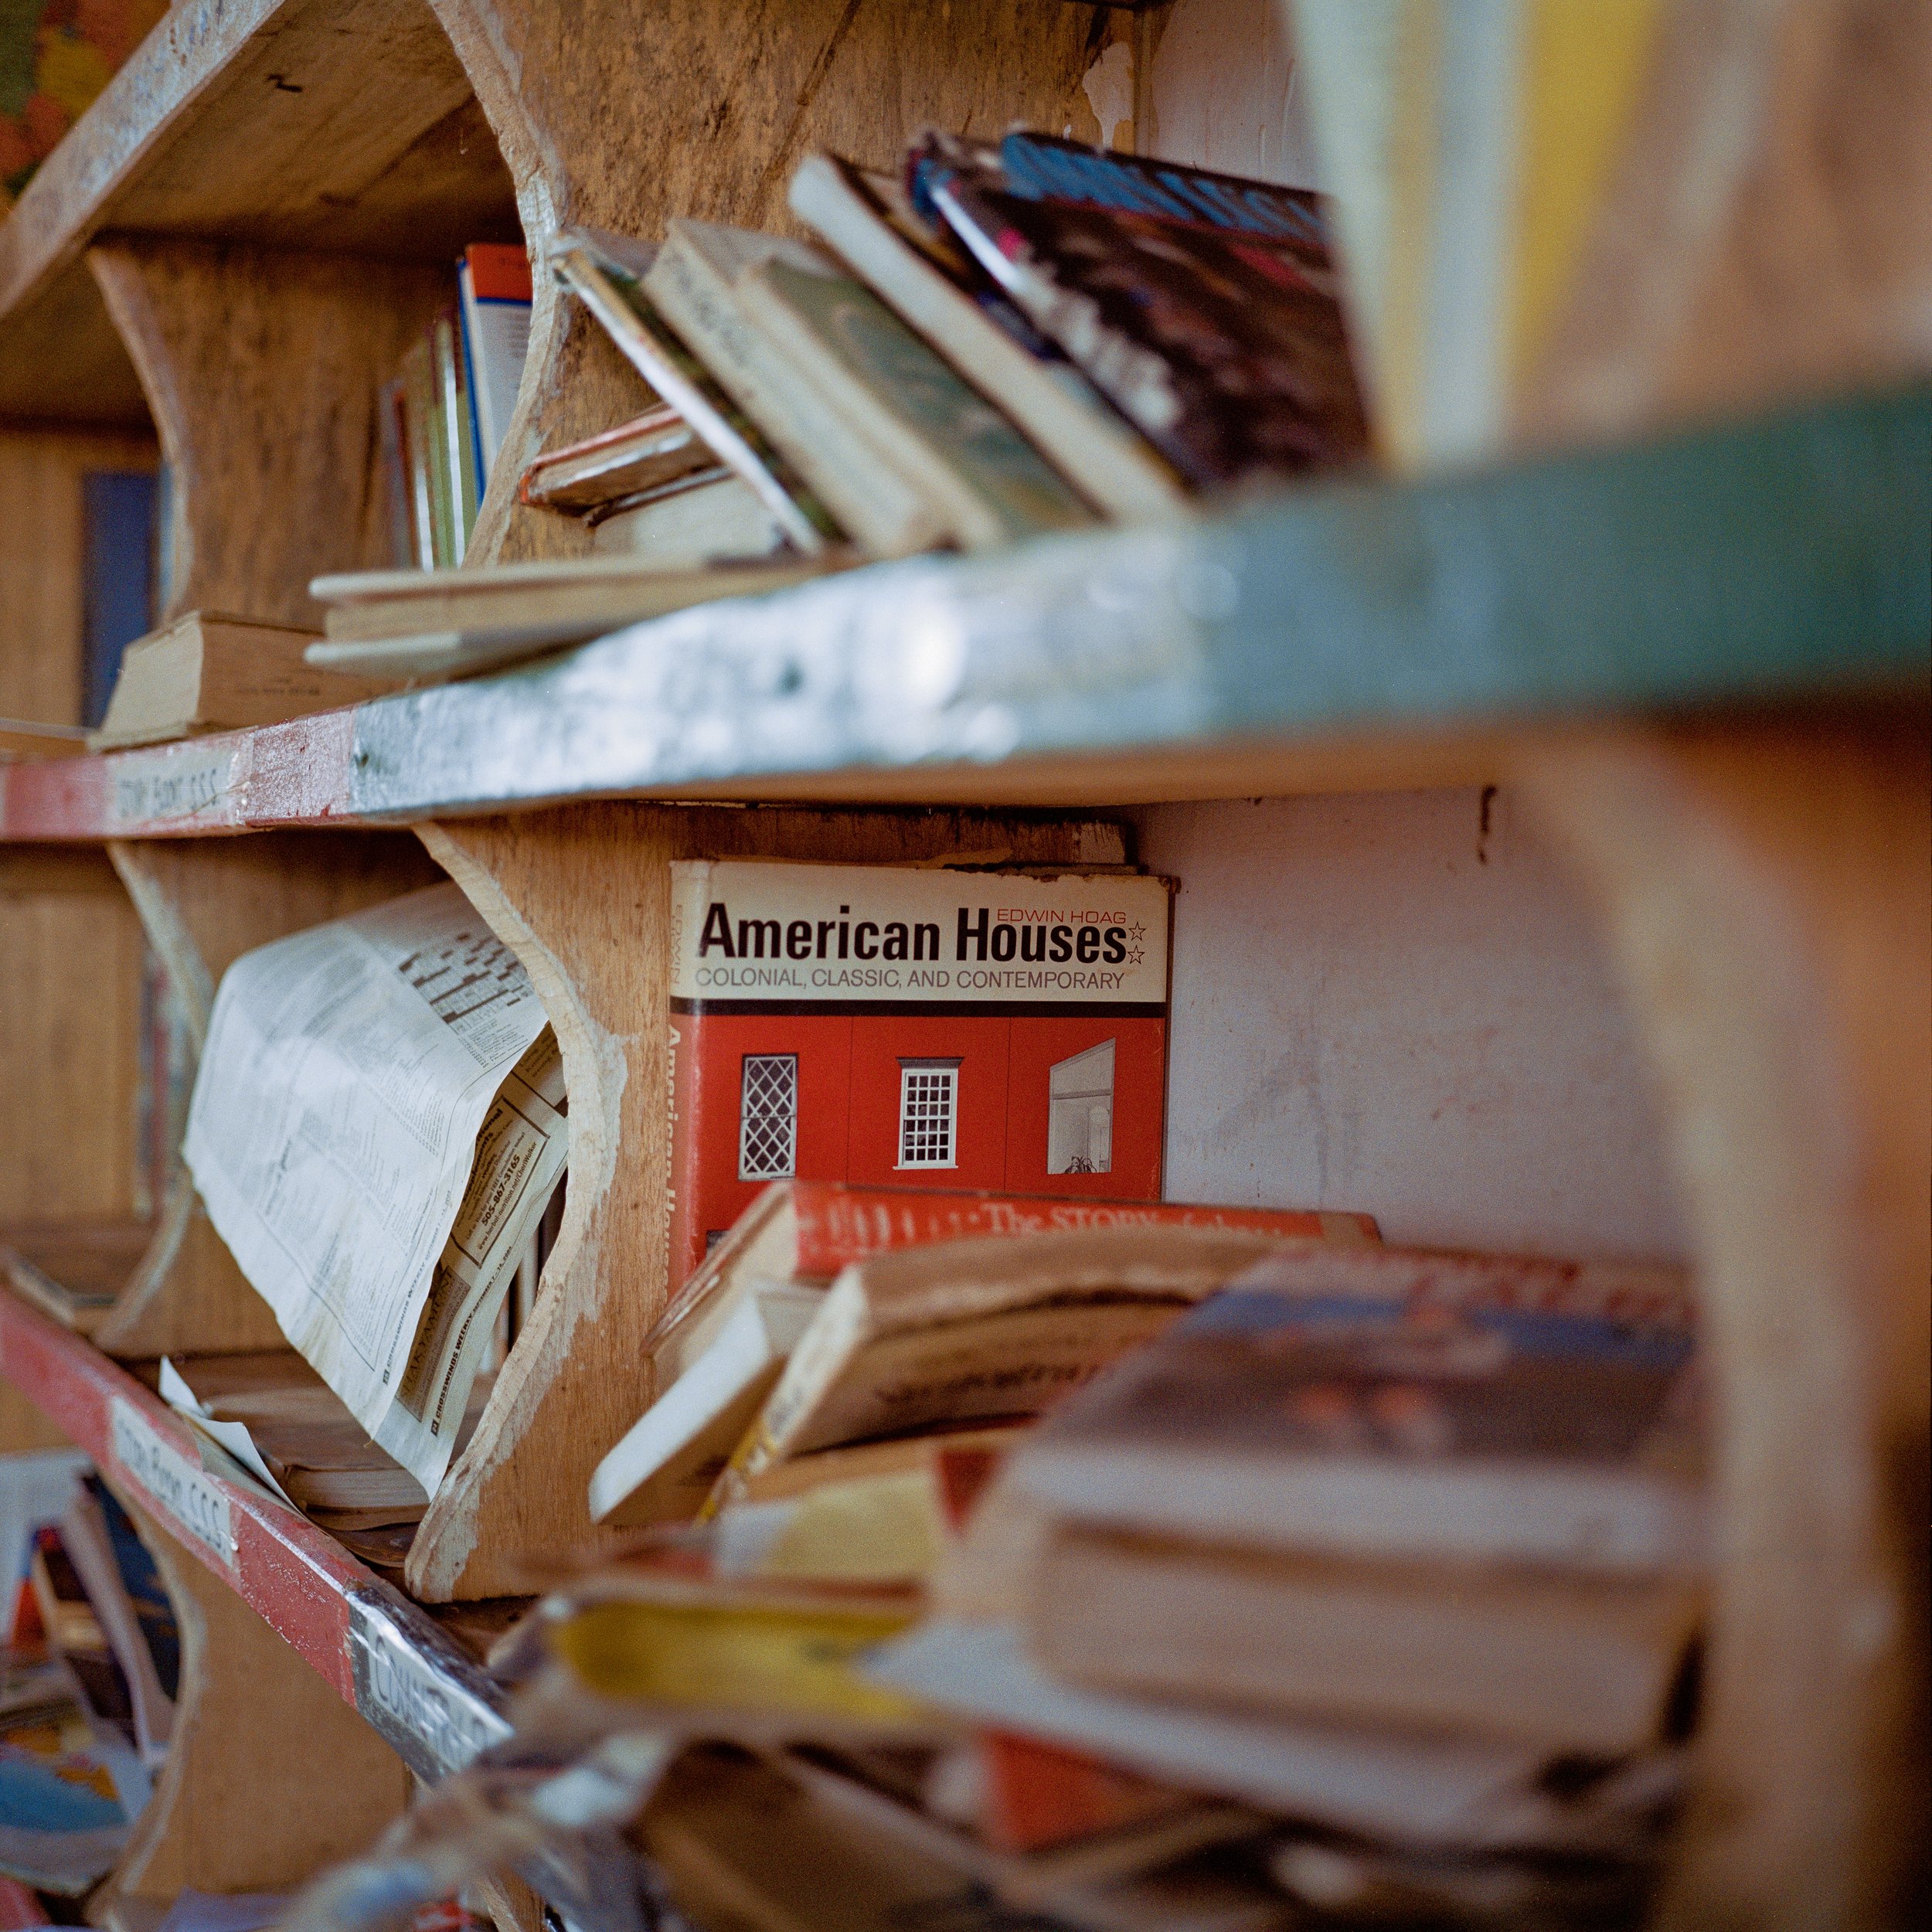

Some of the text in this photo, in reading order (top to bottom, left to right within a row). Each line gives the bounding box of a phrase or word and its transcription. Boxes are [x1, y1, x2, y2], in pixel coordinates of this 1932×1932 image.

[697, 902, 940, 961] American
[956, 907, 1128, 964] Houses
[997, 909, 1127, 924] EDWIN HOAG
[696, 968, 1125, 990] COLONIAL, CLASSIC, AND CONTEMPORARY
[480, 1154, 520, 1226] 505-867-3165
[434, 1351, 459, 1419] CROSSWINDS
[454, 1312, 473, 1350] WEEKLY
[472, 1280, 493, 1312] SEPTEMBER
